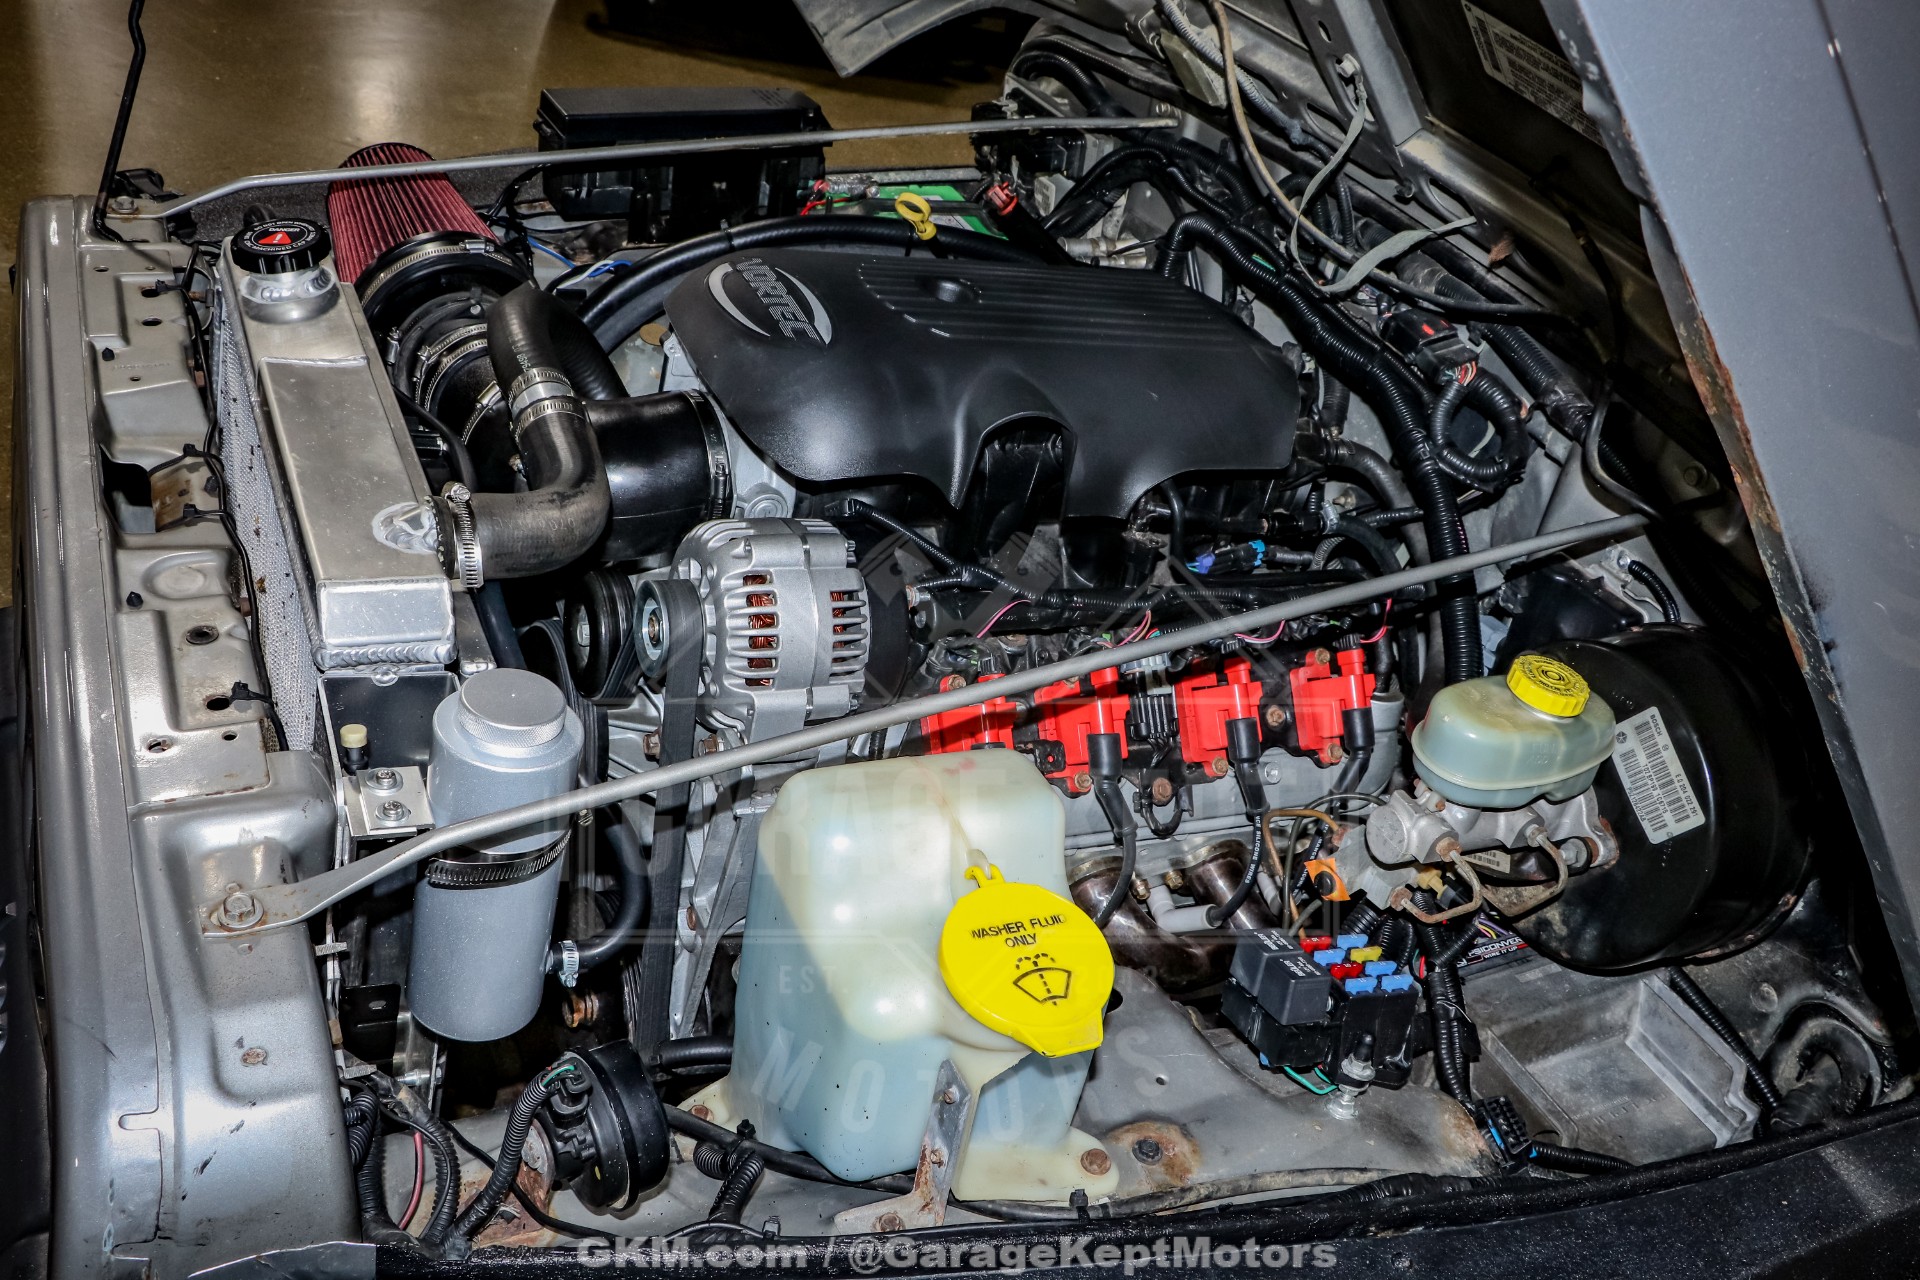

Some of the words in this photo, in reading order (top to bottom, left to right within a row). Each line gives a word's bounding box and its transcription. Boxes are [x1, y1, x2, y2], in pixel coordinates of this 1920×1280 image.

[1650, 714, 1663, 737] BOSCH
[1253, 831, 1261, 860] SILICONE
[1245, 864, 1256, 884] WIRES
[970, 921, 1027, 939] WASHER
[1005, 933, 1037, 948] ONLY
[1484, 951, 1501, 959] WIRE
[1509, 945, 1518, 953] UP
